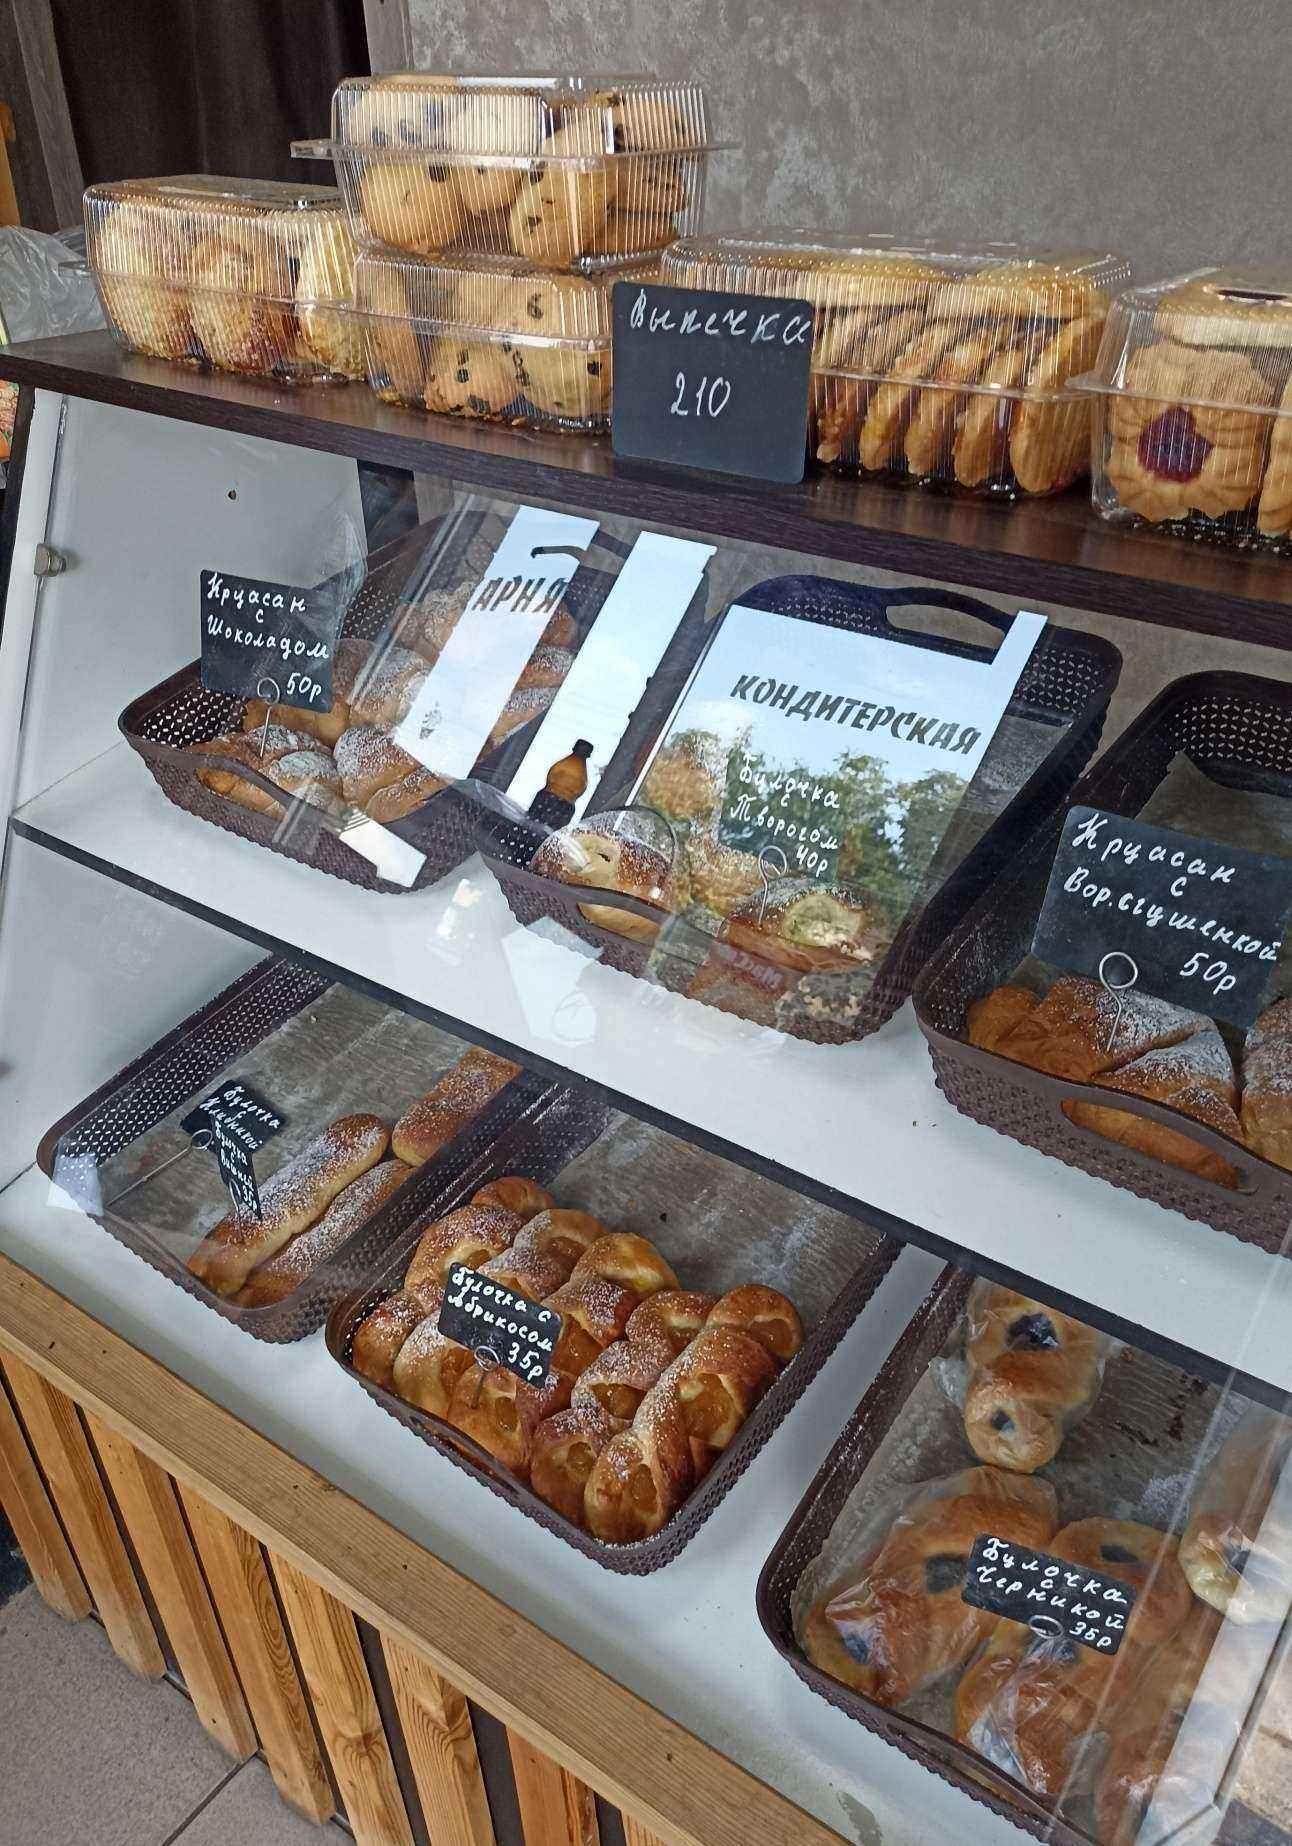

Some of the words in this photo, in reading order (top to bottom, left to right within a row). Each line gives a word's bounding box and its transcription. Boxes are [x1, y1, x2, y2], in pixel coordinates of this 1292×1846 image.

[630, 288, 812, 346] Выпечка
[670, 371, 732, 418] 210
[207, 572, 306, 613] Круасан
[207, 614, 329, 660] Шоколадом
[286, 672, 322, 703] 50р
[730, 674, 982, 755] КОНДИТЕРСКАЯ
[730, 793, 838, 851] Творогом
[796, 844, 829, 878] 40р
[1072, 812, 1237, 884] Круасан
[1179, 952, 1238, 996] 50р
[507, 1341, 544, 1382] 35р
[982, 1536, 1129, 1605] Булочка
[976, 1565, 1125, 1630] Черникой
[1069, 1620, 1113, 1648] 35р
